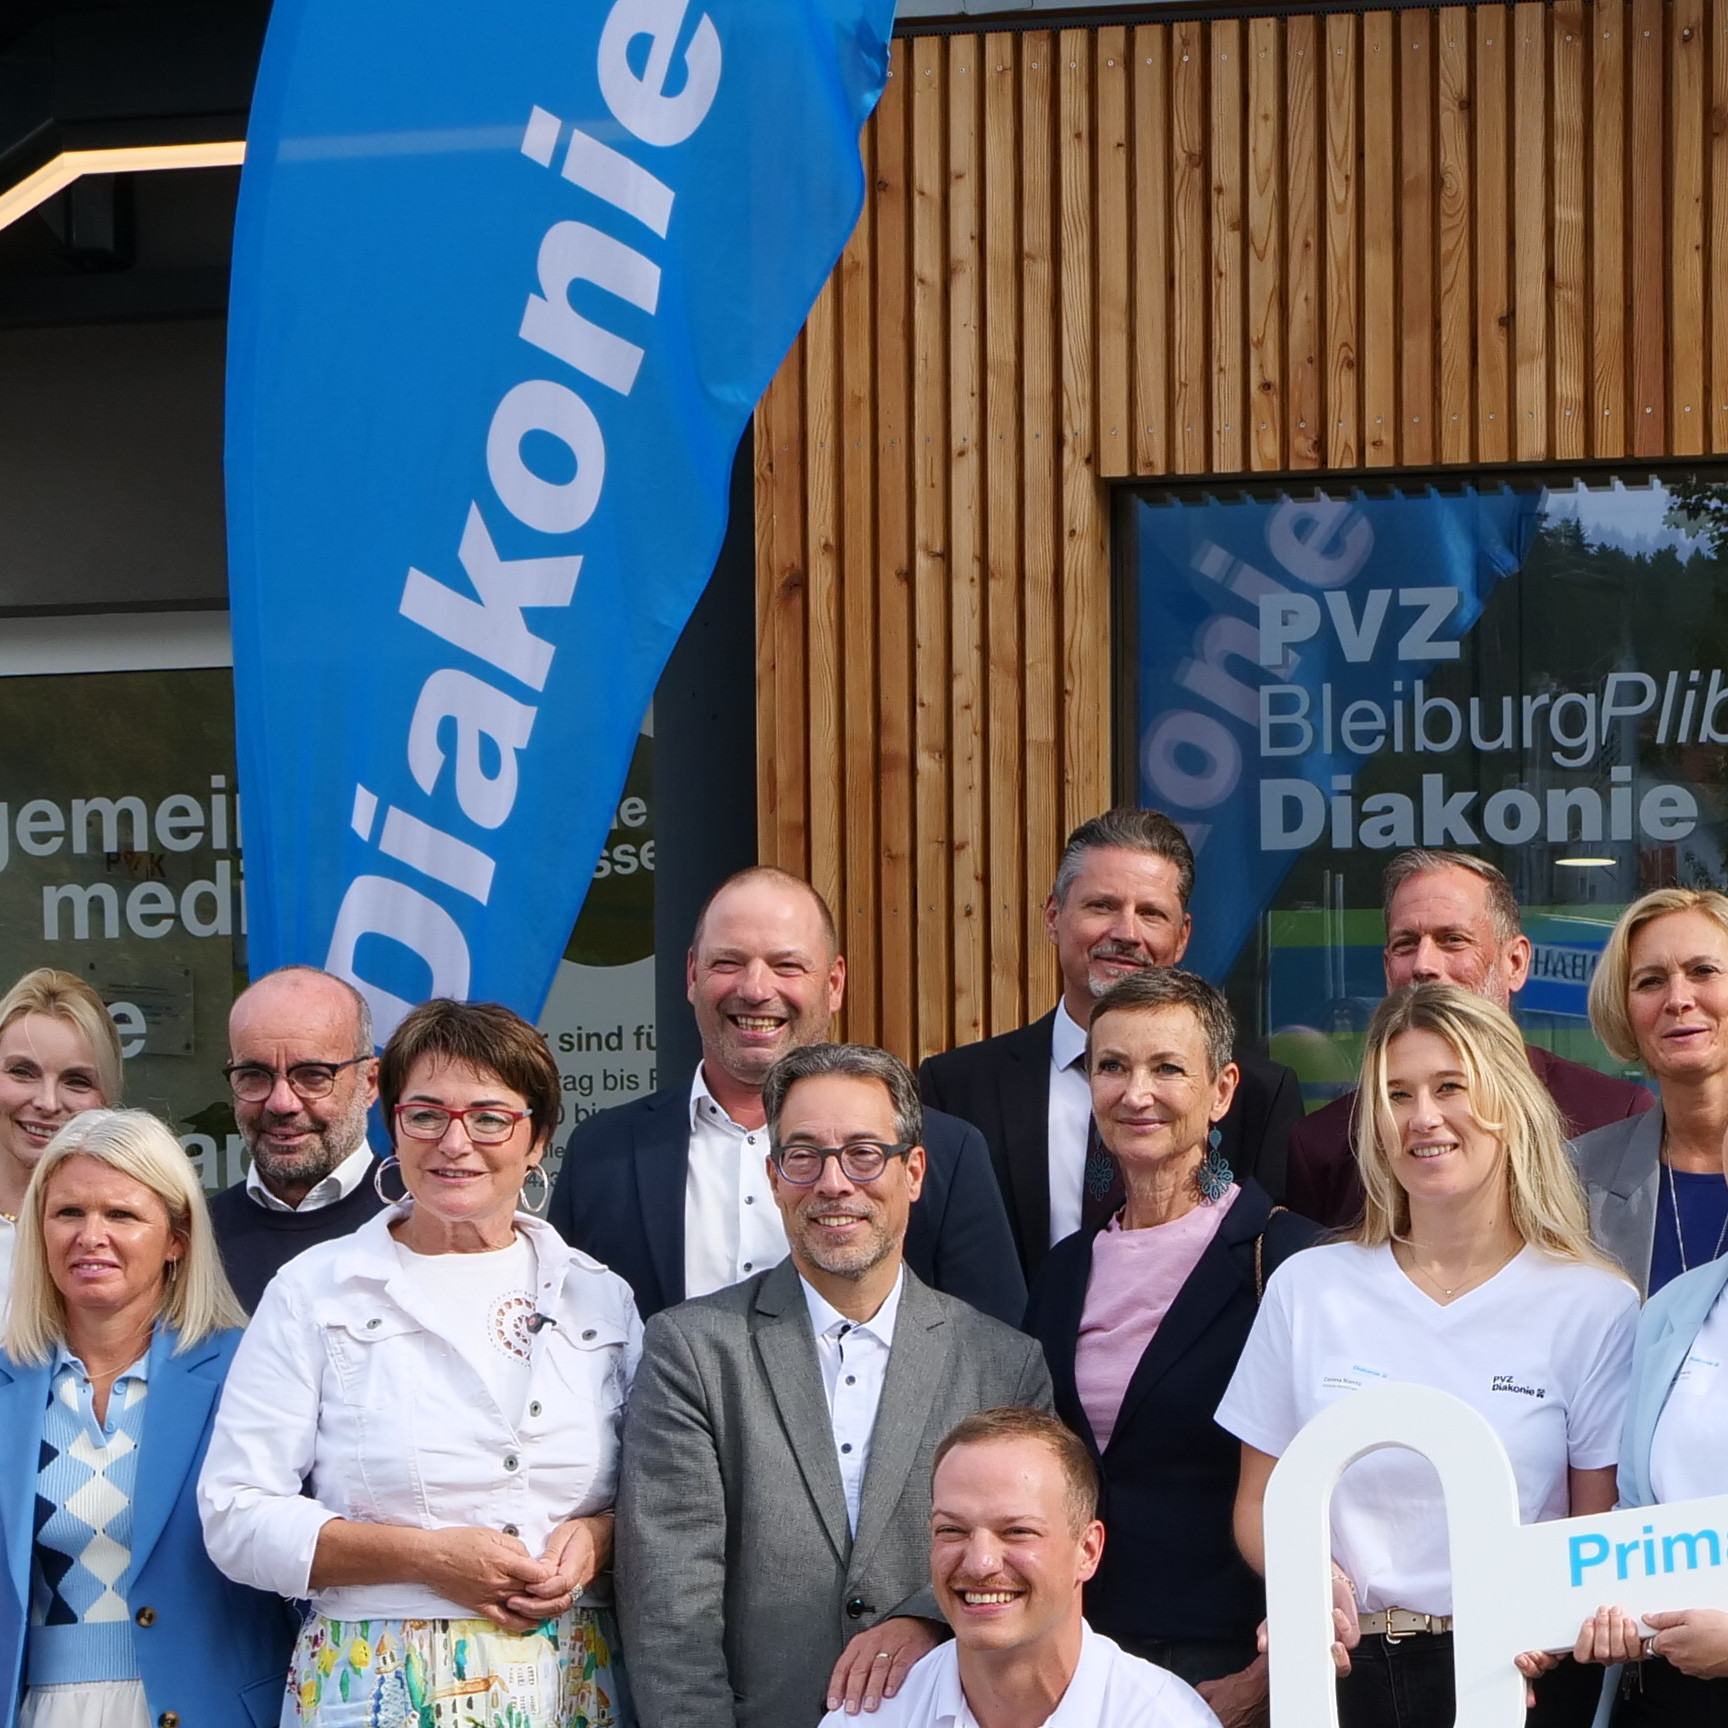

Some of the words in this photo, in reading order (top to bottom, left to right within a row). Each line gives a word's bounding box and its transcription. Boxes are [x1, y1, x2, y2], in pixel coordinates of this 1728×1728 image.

[1259, 587, 1460, 667] PVZ
[1259, 765, 1697, 852] Diakonie
[558, 1025, 623, 1052] sind
[603, 1068, 640, 1091] bis
[1491, 1383, 1535, 1396] Diakonie
